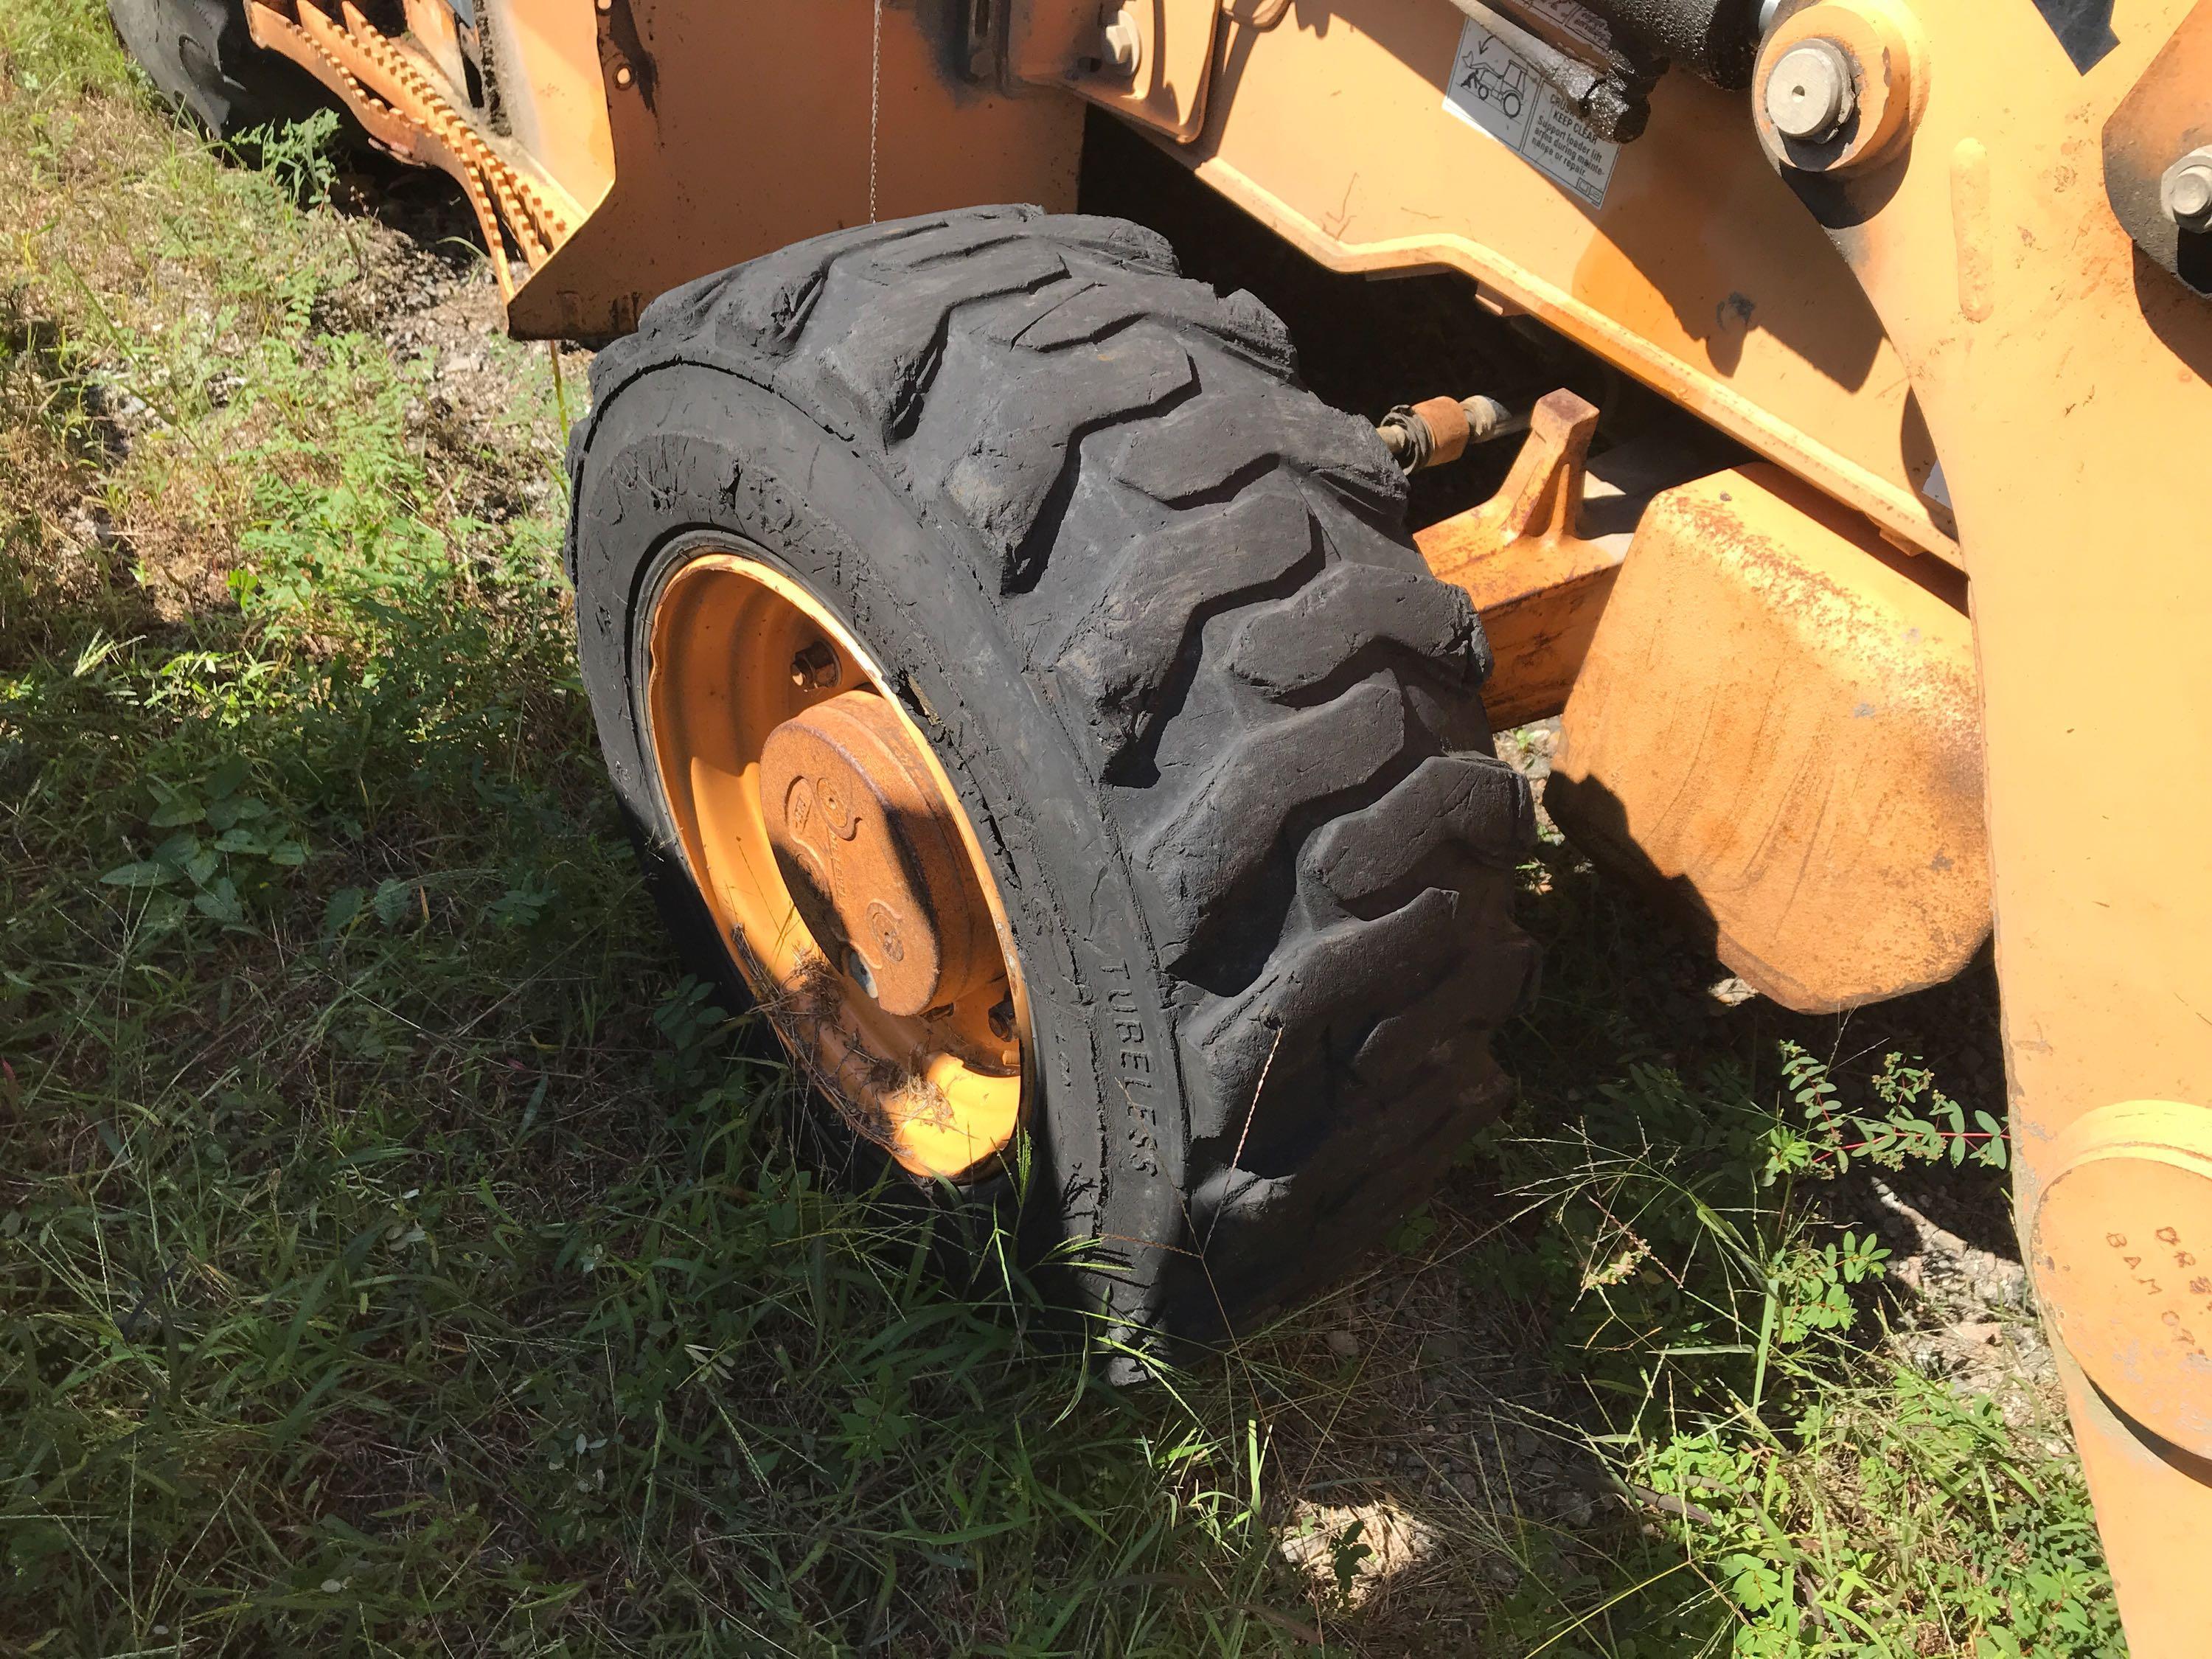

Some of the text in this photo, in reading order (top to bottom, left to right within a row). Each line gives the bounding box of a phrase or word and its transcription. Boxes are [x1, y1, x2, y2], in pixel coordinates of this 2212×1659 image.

[1531, 137, 1554, 155] nance
[1554, 152, 1563, 161] or
[1534, 127, 1604, 175] arms during mainte-
[1537, 115, 1602, 163] Support loader lift
[1553, 110, 1599, 145] KEEP CLEAR
[1099, 959, 1158, 1178] TUBELESS
